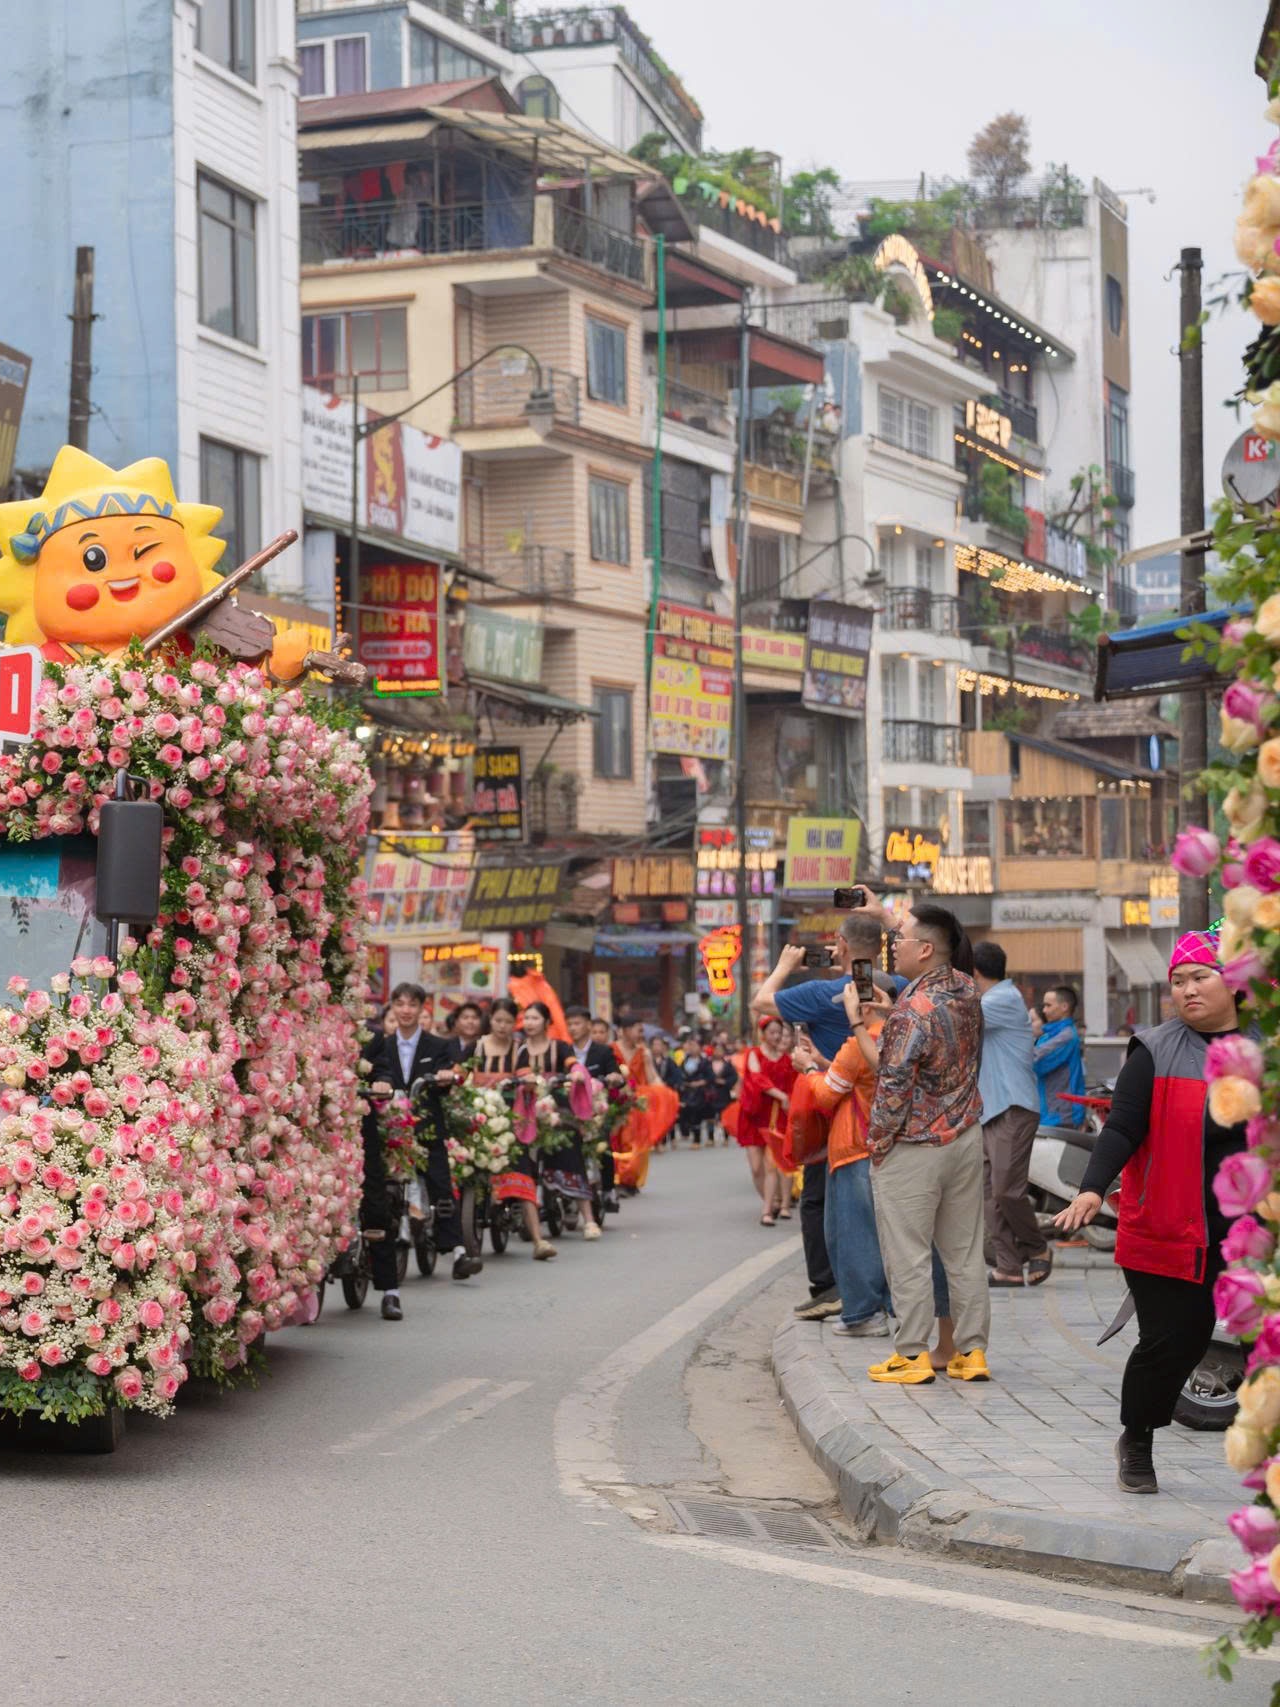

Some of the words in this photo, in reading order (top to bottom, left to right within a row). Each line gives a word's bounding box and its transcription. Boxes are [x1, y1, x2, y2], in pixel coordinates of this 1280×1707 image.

[1248, 438, 1274, 458] K+
[359, 566, 401, 602] PHỞ
[791, 855, 821, 883] QUANG
[825, 855, 852, 883] TRUNG
